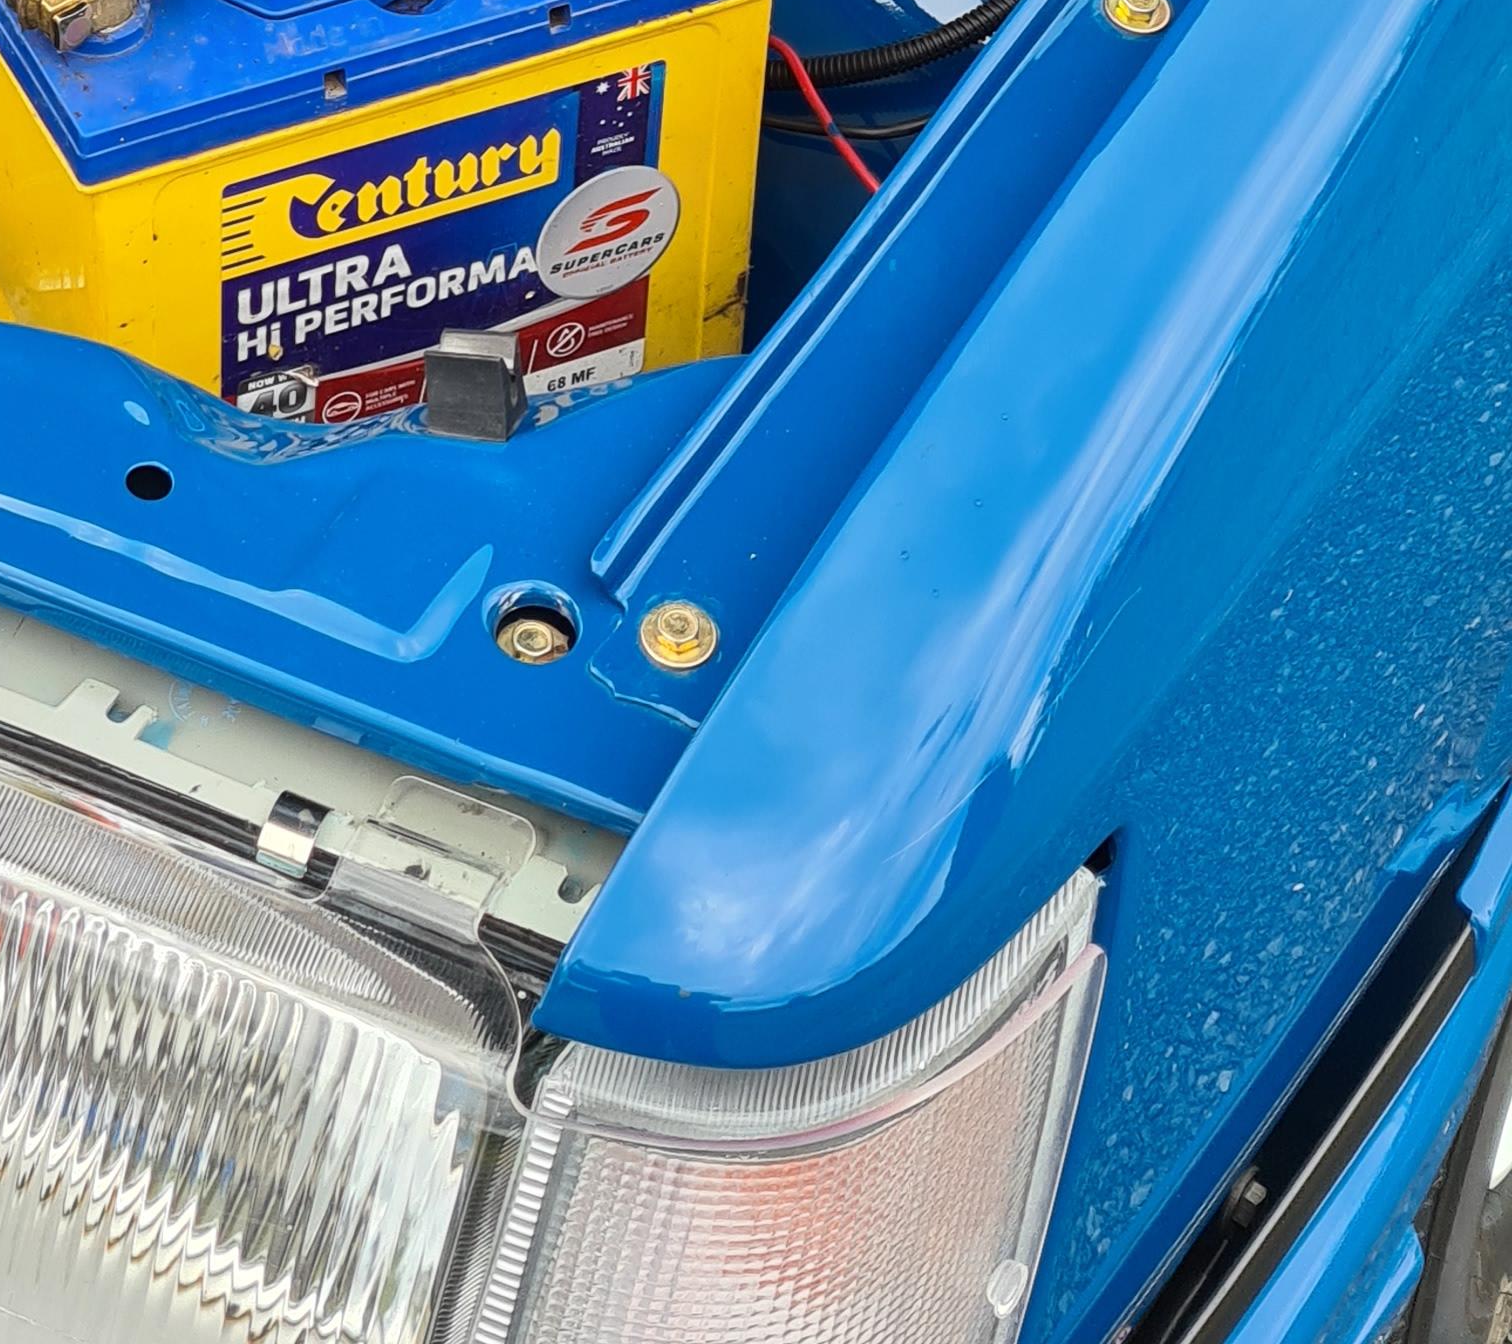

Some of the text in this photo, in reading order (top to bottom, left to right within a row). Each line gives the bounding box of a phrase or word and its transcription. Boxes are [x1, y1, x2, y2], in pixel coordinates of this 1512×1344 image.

[288, 127, 562, 242] Century
[549, 231, 666, 276] SUPERCARS
[608, 246, 654, 267] BATTERY
[237, 243, 413, 326] ULTRA
[247, 374, 276, 392] NOW
[546, 366, 597, 393] 68 MF
[249, 380, 308, 418] 40
